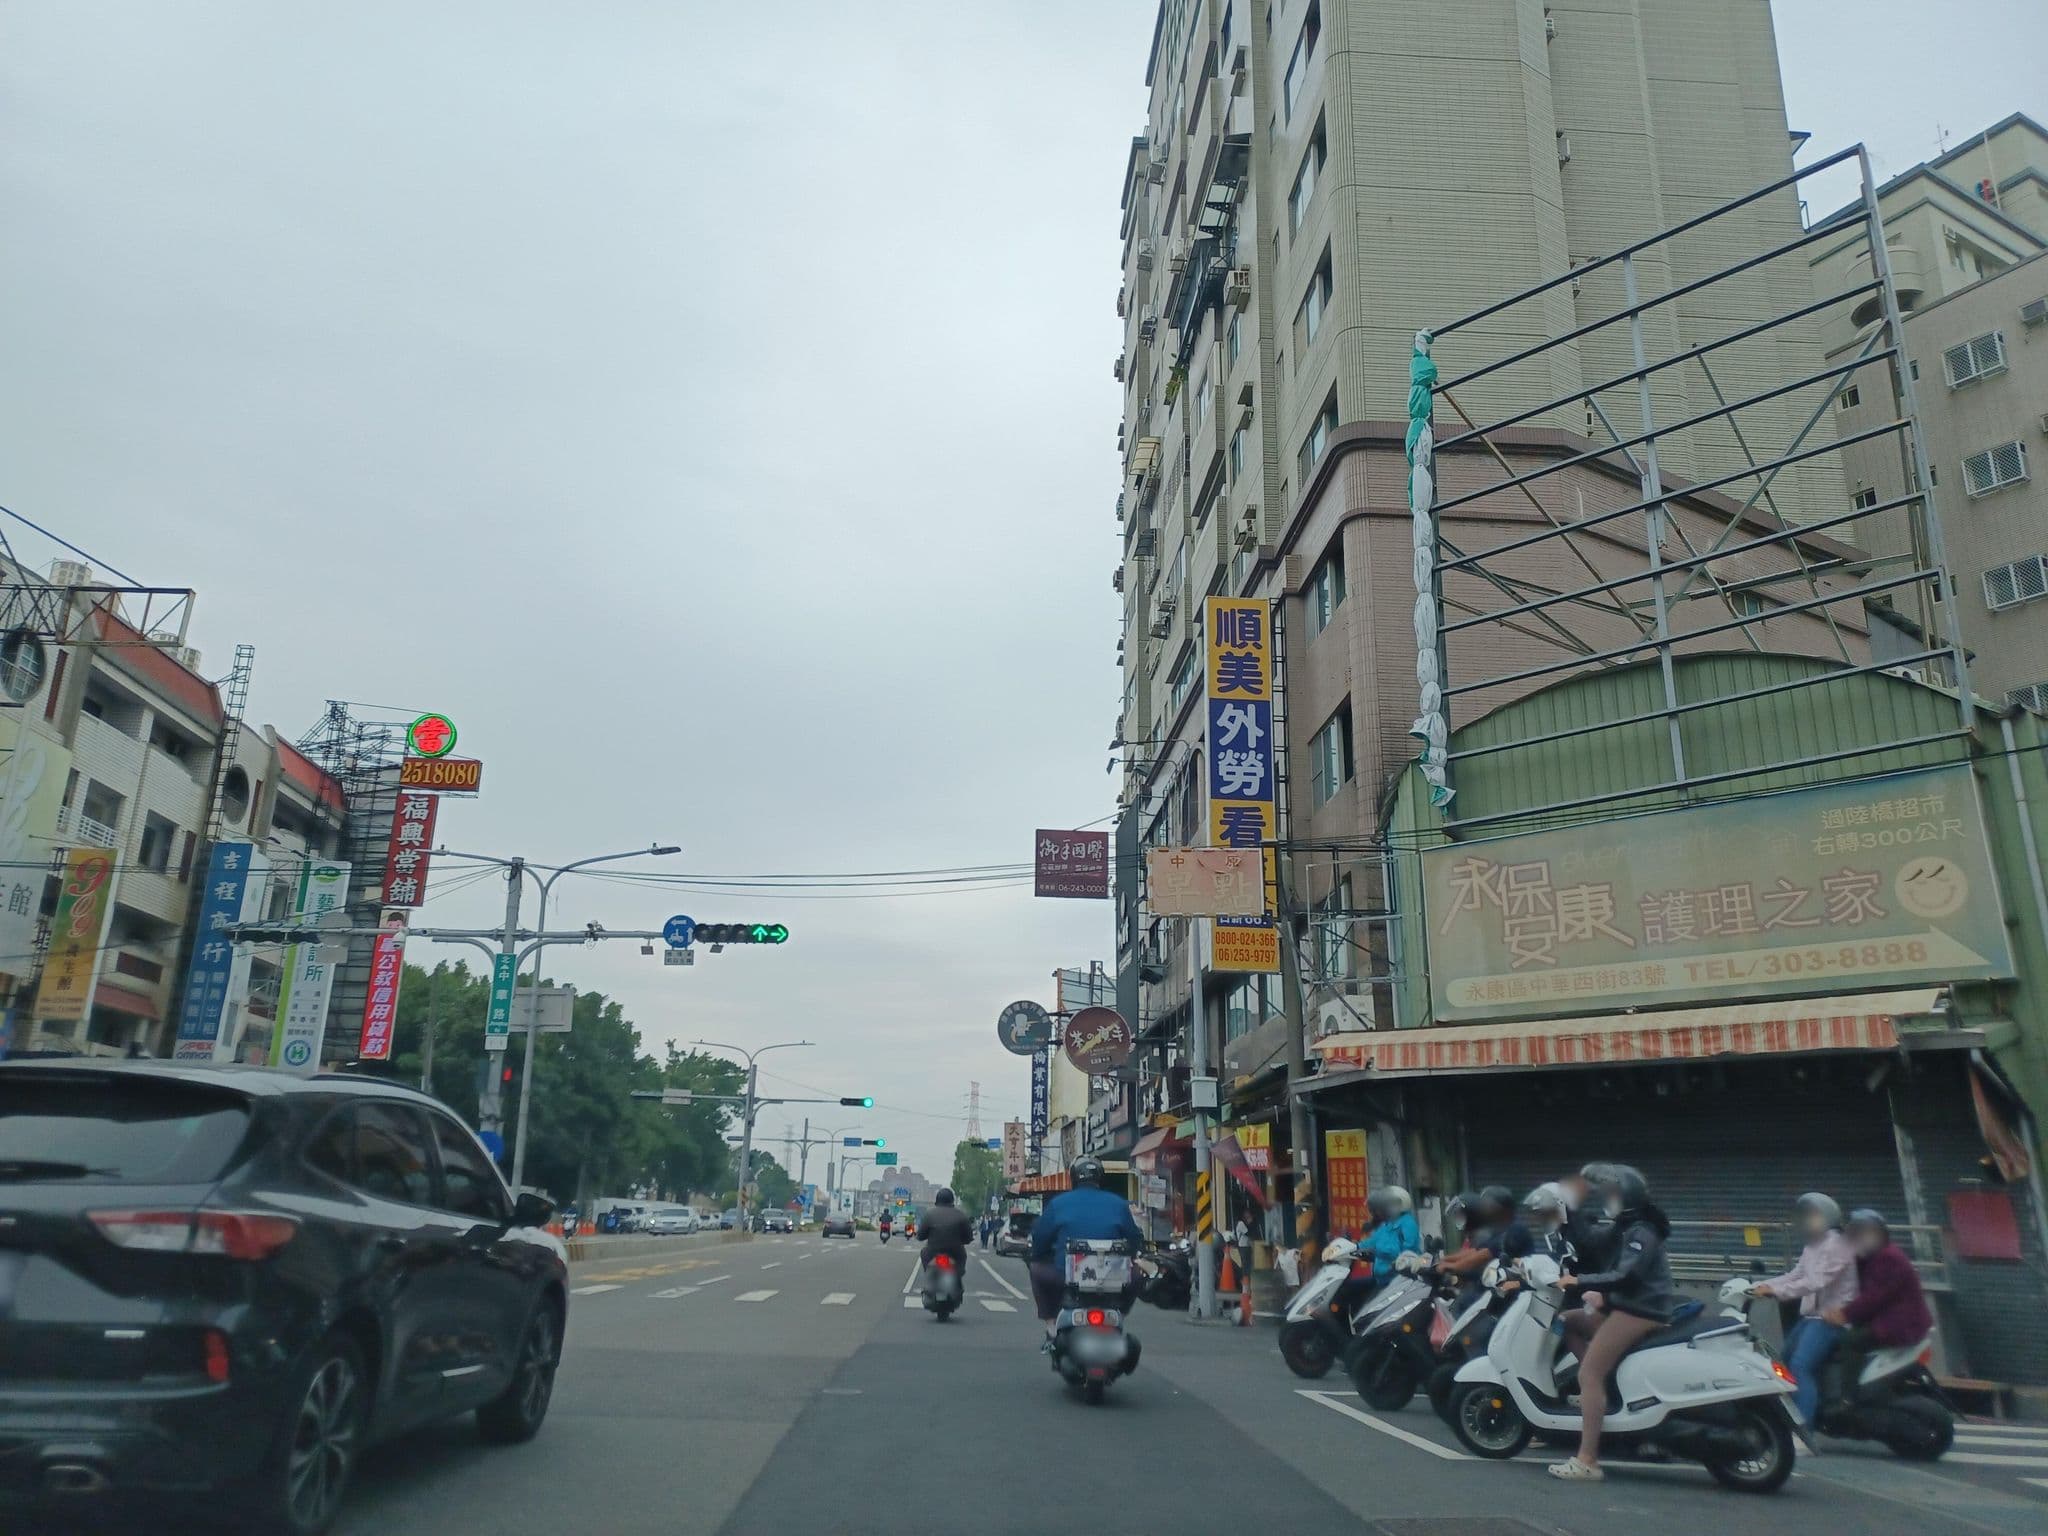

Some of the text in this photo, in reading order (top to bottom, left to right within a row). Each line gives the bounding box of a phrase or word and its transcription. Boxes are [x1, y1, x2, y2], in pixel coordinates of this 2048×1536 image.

[1215, 607, 1266, 850] 順美外勞看
[401, 760, 479, 785] 2518080
[1821, 795, 1946, 830] 過陸橋超市
[1811, 818, 1966, 856] 右轉300公尺
[201, 850, 242, 963] 吉程商行
[1639, 867, 1887, 946] 護理之家
[1215, 931, 1276, 946] 0800-024-366
[1215, 948, 1276, 963] (06)253-9797
